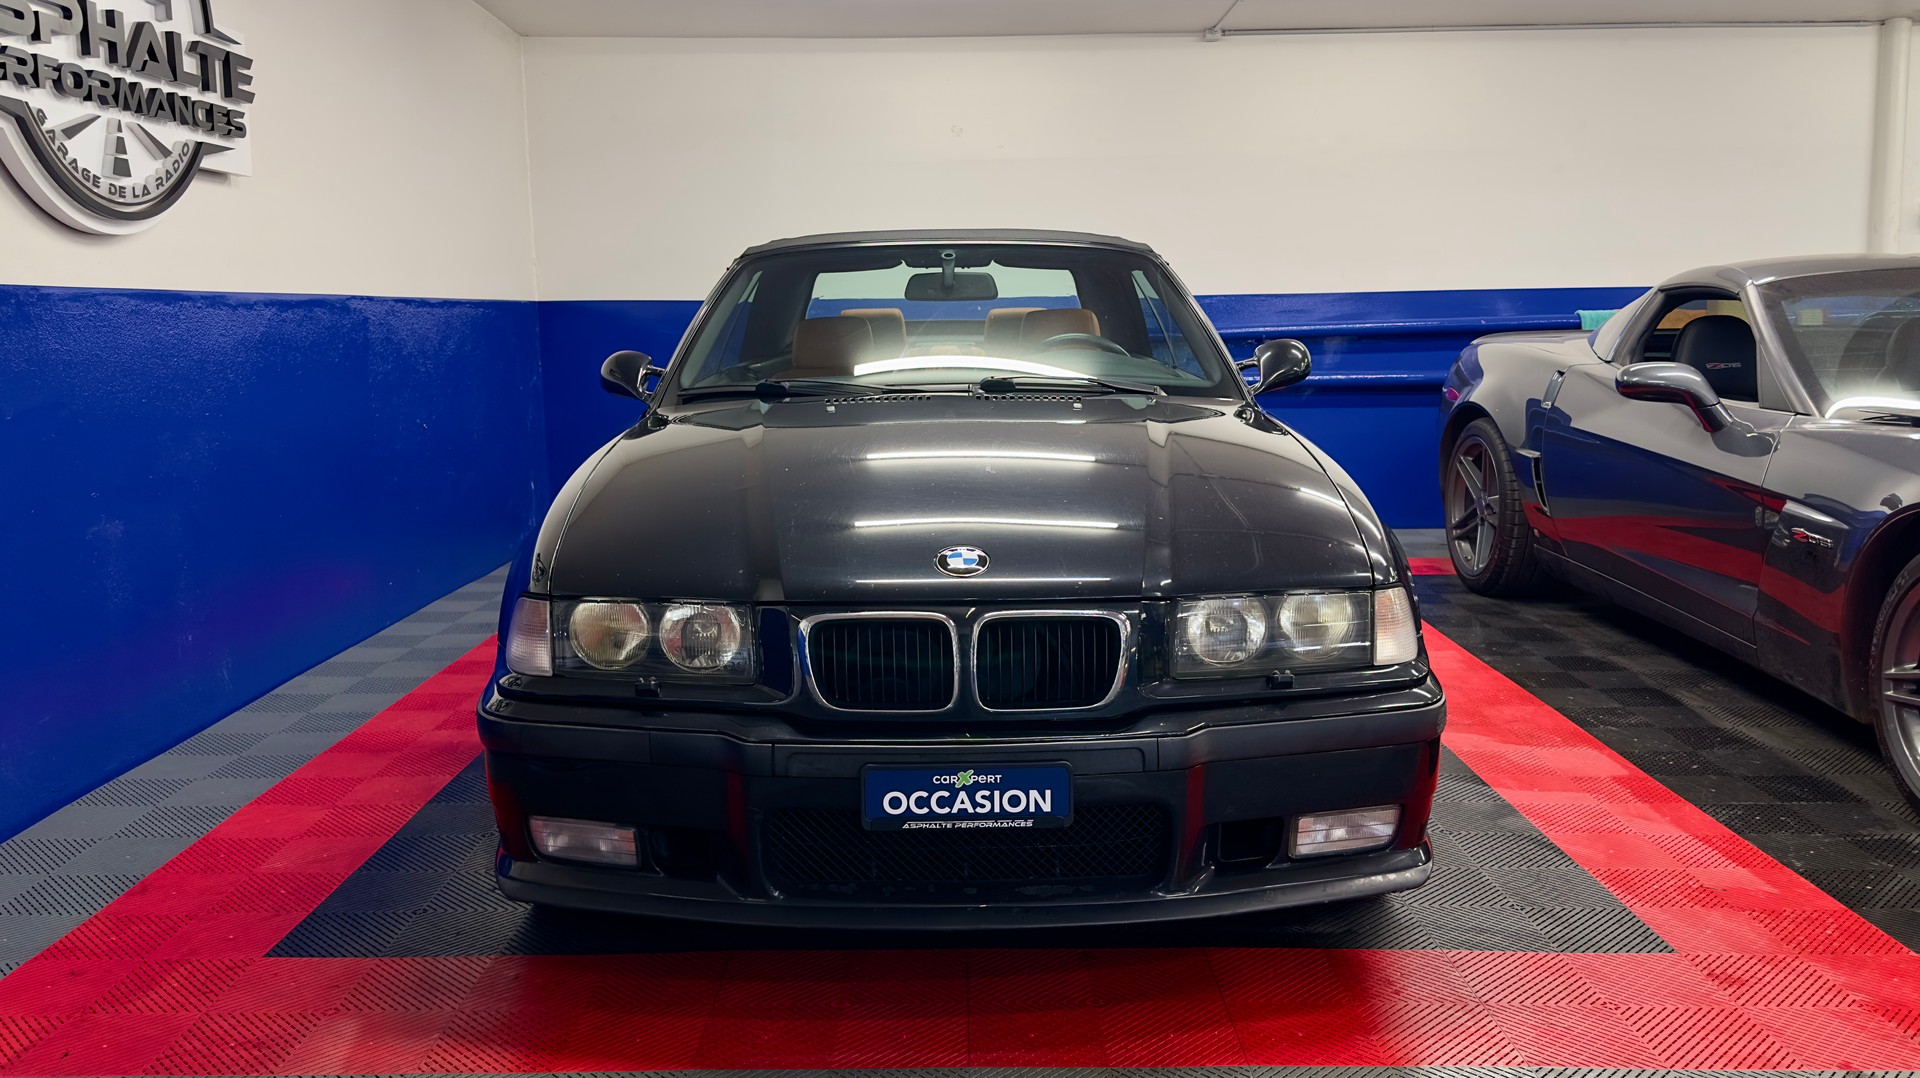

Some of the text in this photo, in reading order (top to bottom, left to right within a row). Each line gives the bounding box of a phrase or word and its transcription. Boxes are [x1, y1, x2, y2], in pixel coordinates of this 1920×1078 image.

[36, 108, 190, 199] GARAGE DE LA RADIO
[882, 789, 1051, 815] OCCASION
[902, 819, 1034, 829] ASPHALTE PERFORMANCES
